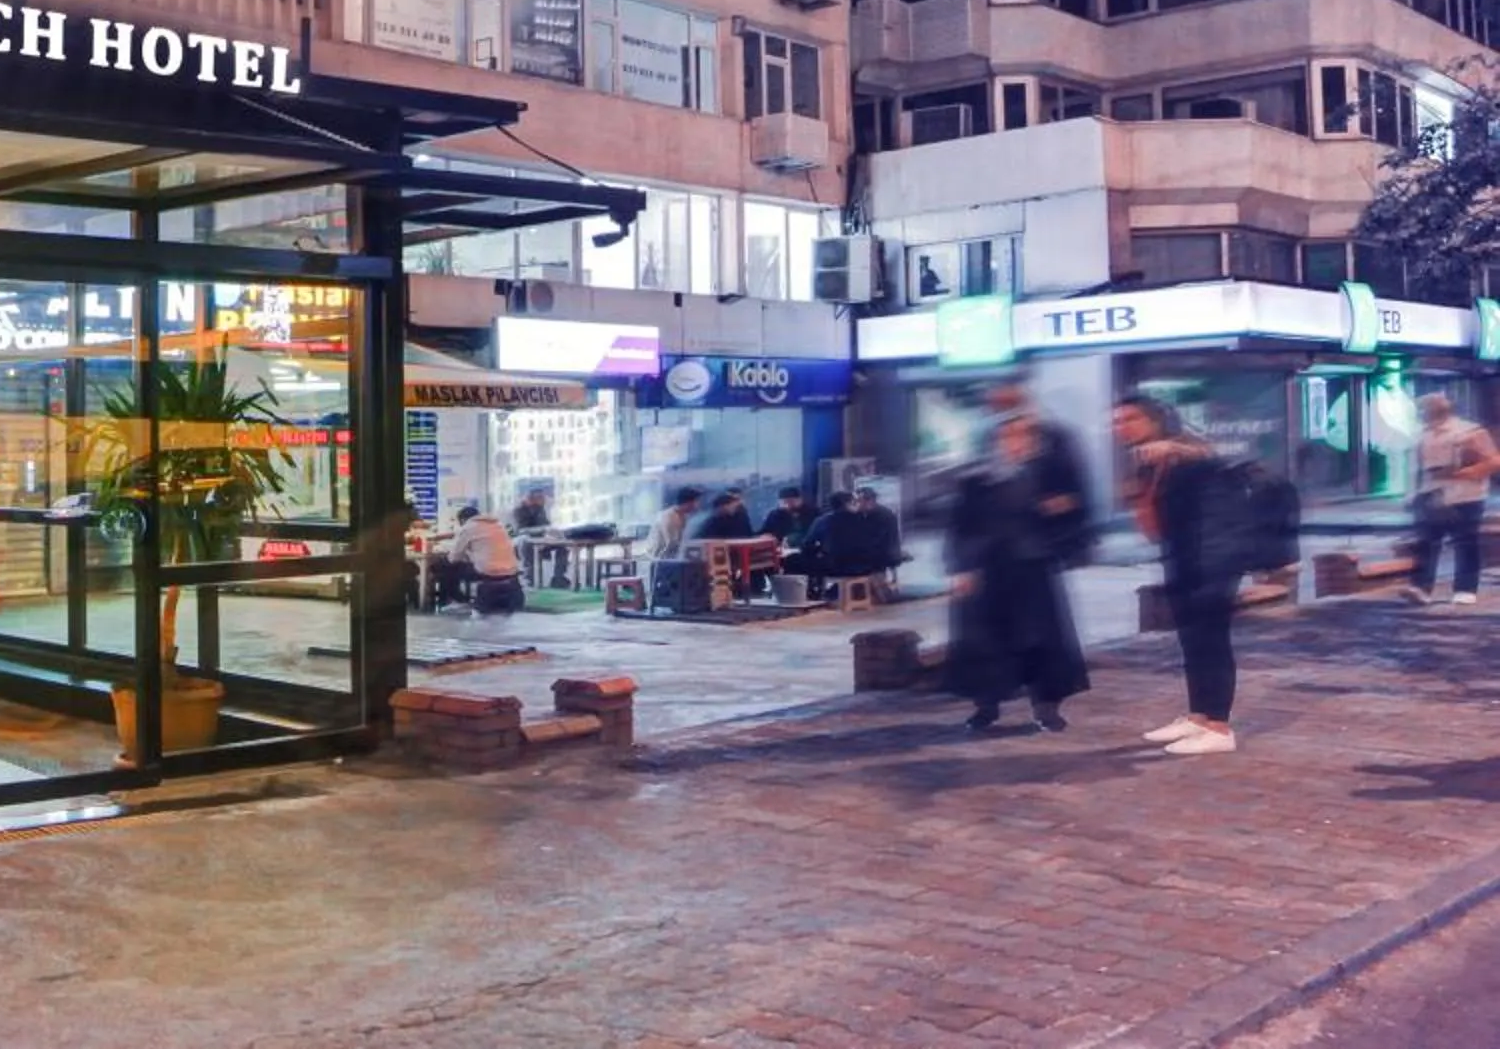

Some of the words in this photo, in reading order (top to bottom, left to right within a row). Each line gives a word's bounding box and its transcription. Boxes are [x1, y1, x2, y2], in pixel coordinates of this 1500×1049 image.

[89, 18, 301, 94] HOTEL
[1043, 305, 1138, 338] TEB
[730, 359, 790, 388] Kablo
[414, 385, 482, 403] MASLAK
